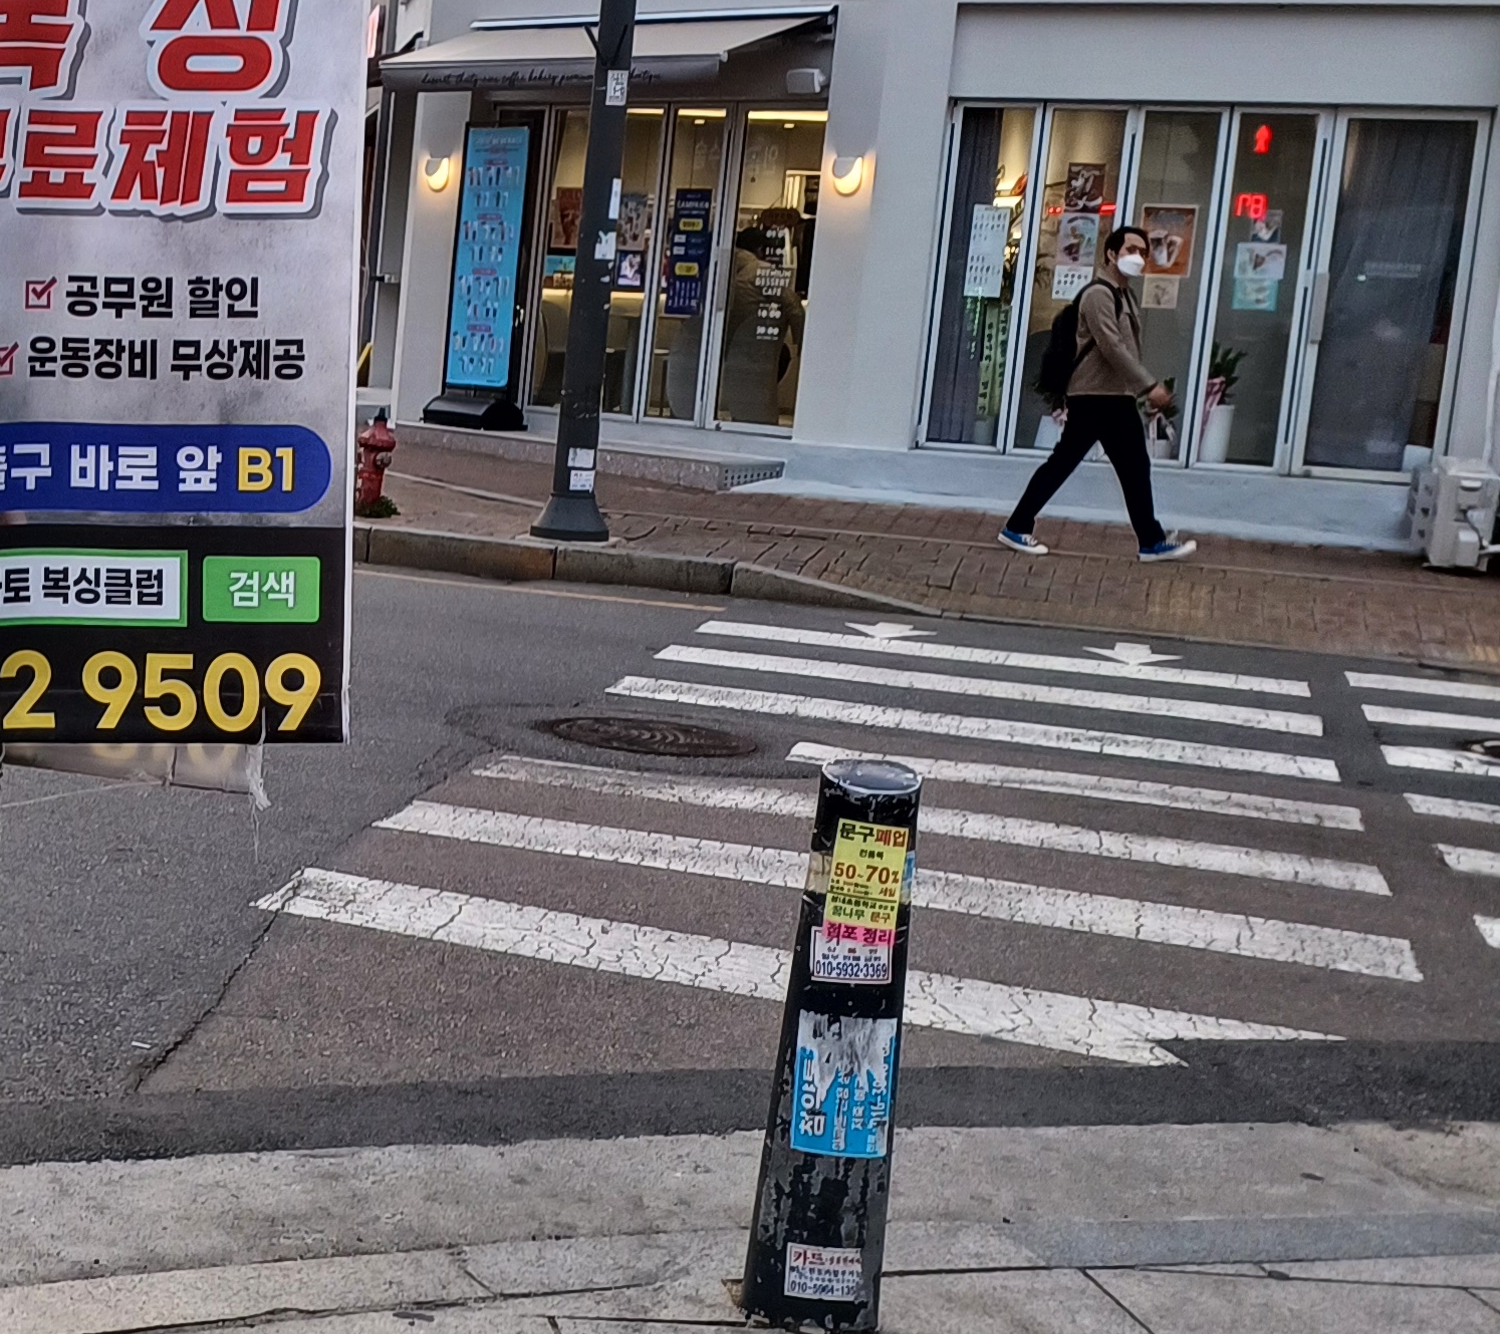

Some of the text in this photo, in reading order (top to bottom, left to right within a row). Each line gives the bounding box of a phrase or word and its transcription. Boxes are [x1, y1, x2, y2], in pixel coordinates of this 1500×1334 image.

[64, 276, 260, 319] 공무원 할인
[26, 336, 306, 382] 운동장비 무상제공
[69, 443, 161, 493] 바로
[176, 443, 222, 494] 앞
[236, 447, 296, 493] B1
[41, 566, 164, 609] 복싱클럽
[227, 570, 296, 610] 검색
[80, 650, 323, 734] 9509
[862, 927, 893, 947] 정리
